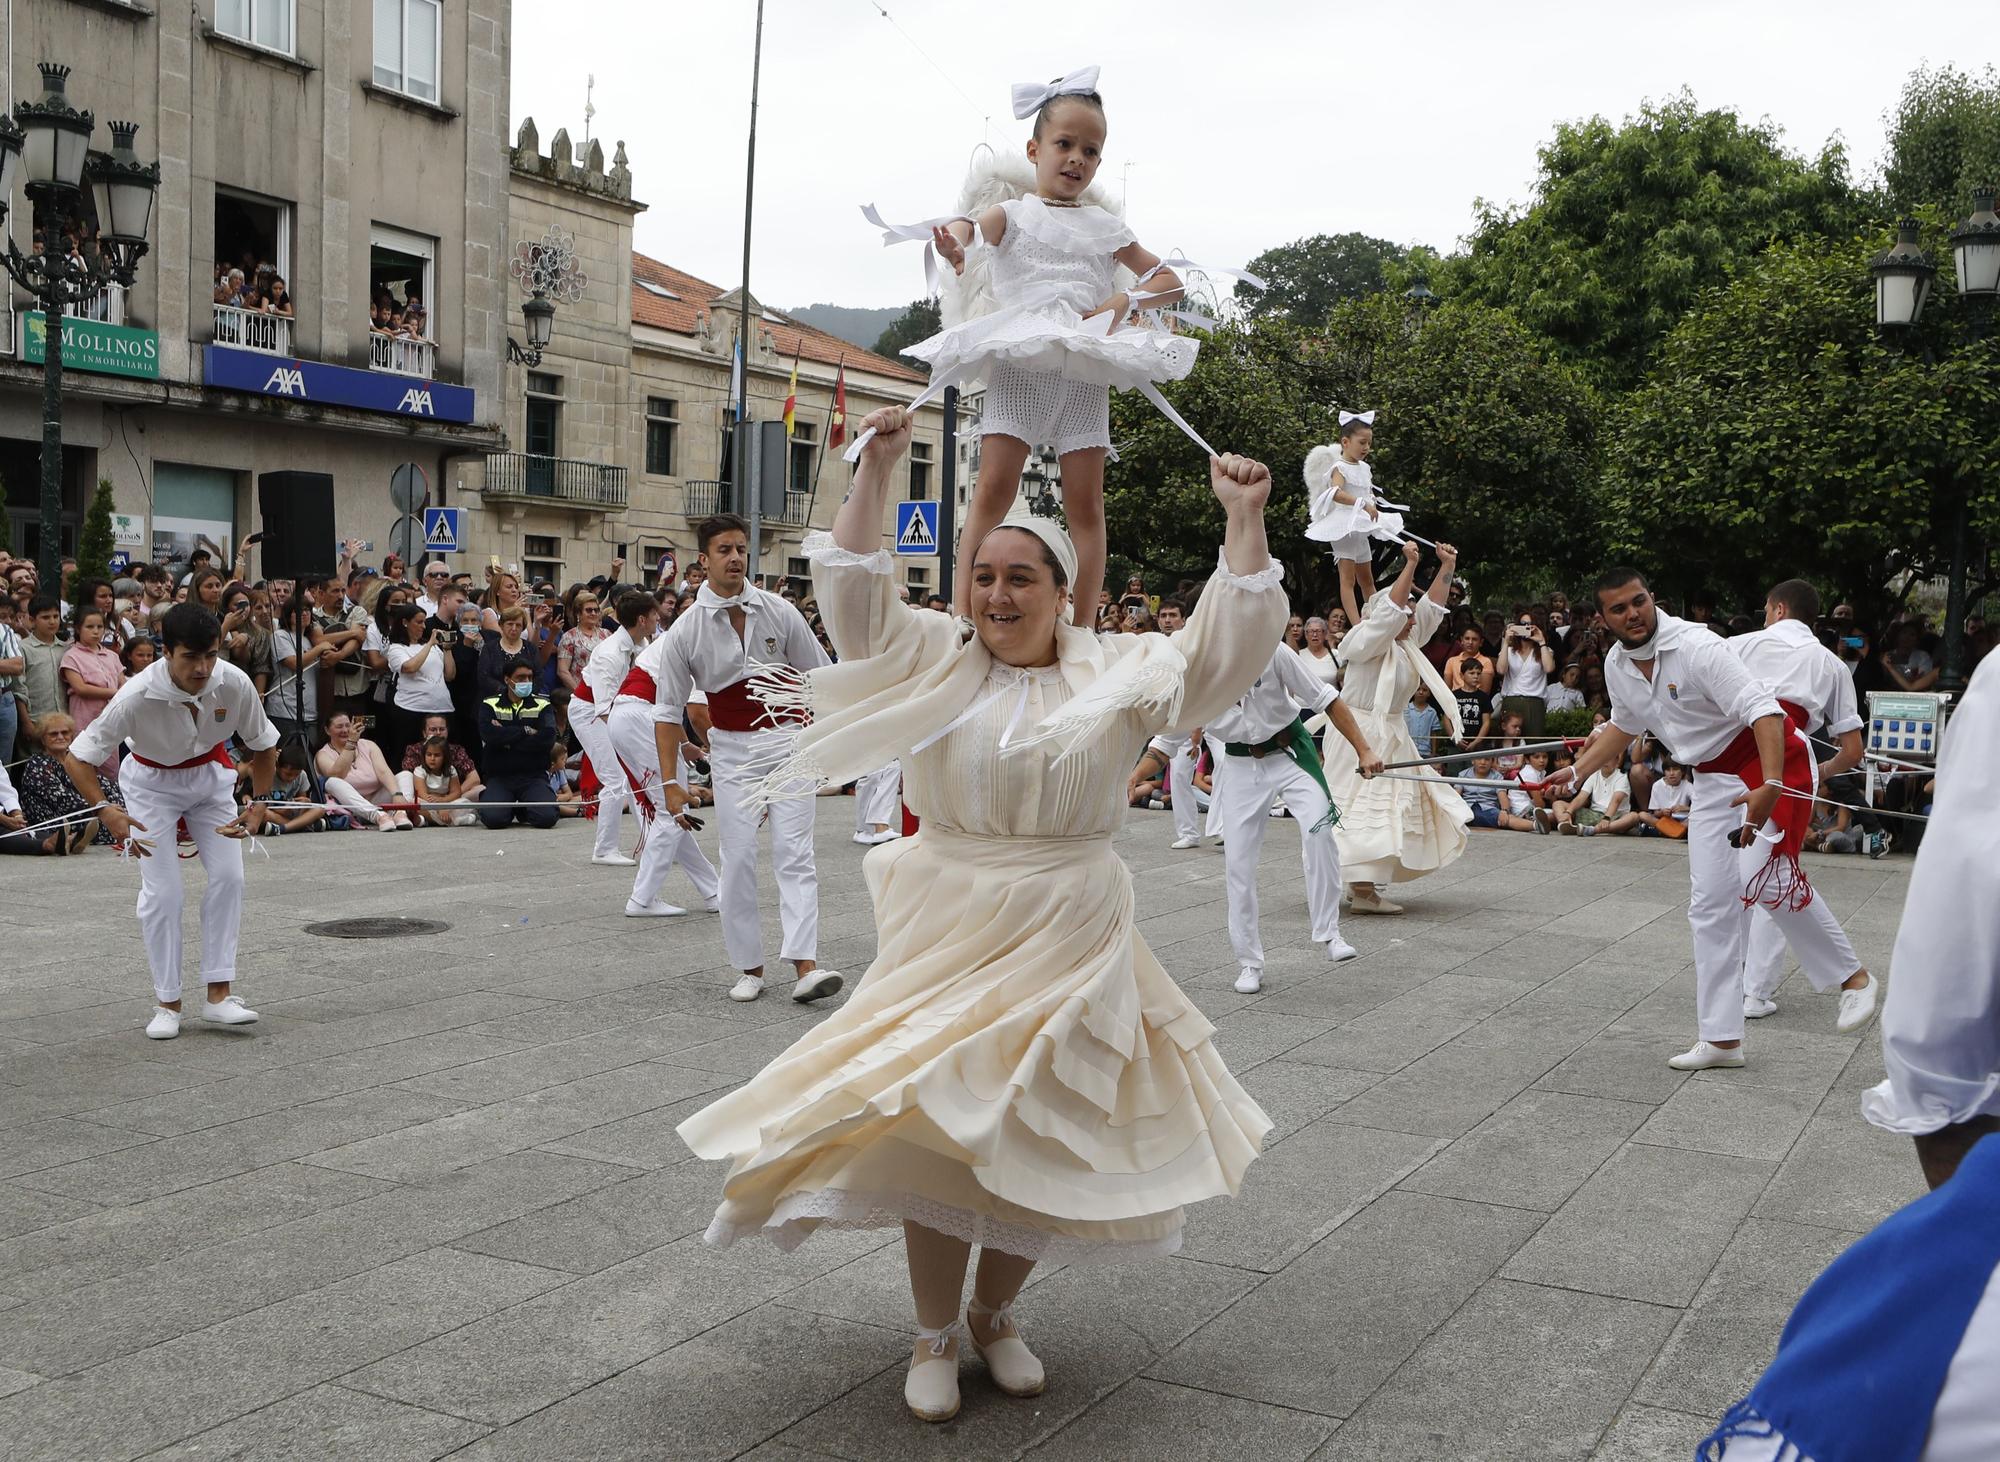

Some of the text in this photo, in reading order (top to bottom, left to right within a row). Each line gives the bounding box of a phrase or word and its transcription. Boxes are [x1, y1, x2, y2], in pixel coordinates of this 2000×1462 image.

[61, 327, 156, 359] MOLINOS
[30, 347, 153, 371] GEON INMOBILIARIA
[263, 367, 306, 397] AXA
[397, 388, 435, 415] AXA
